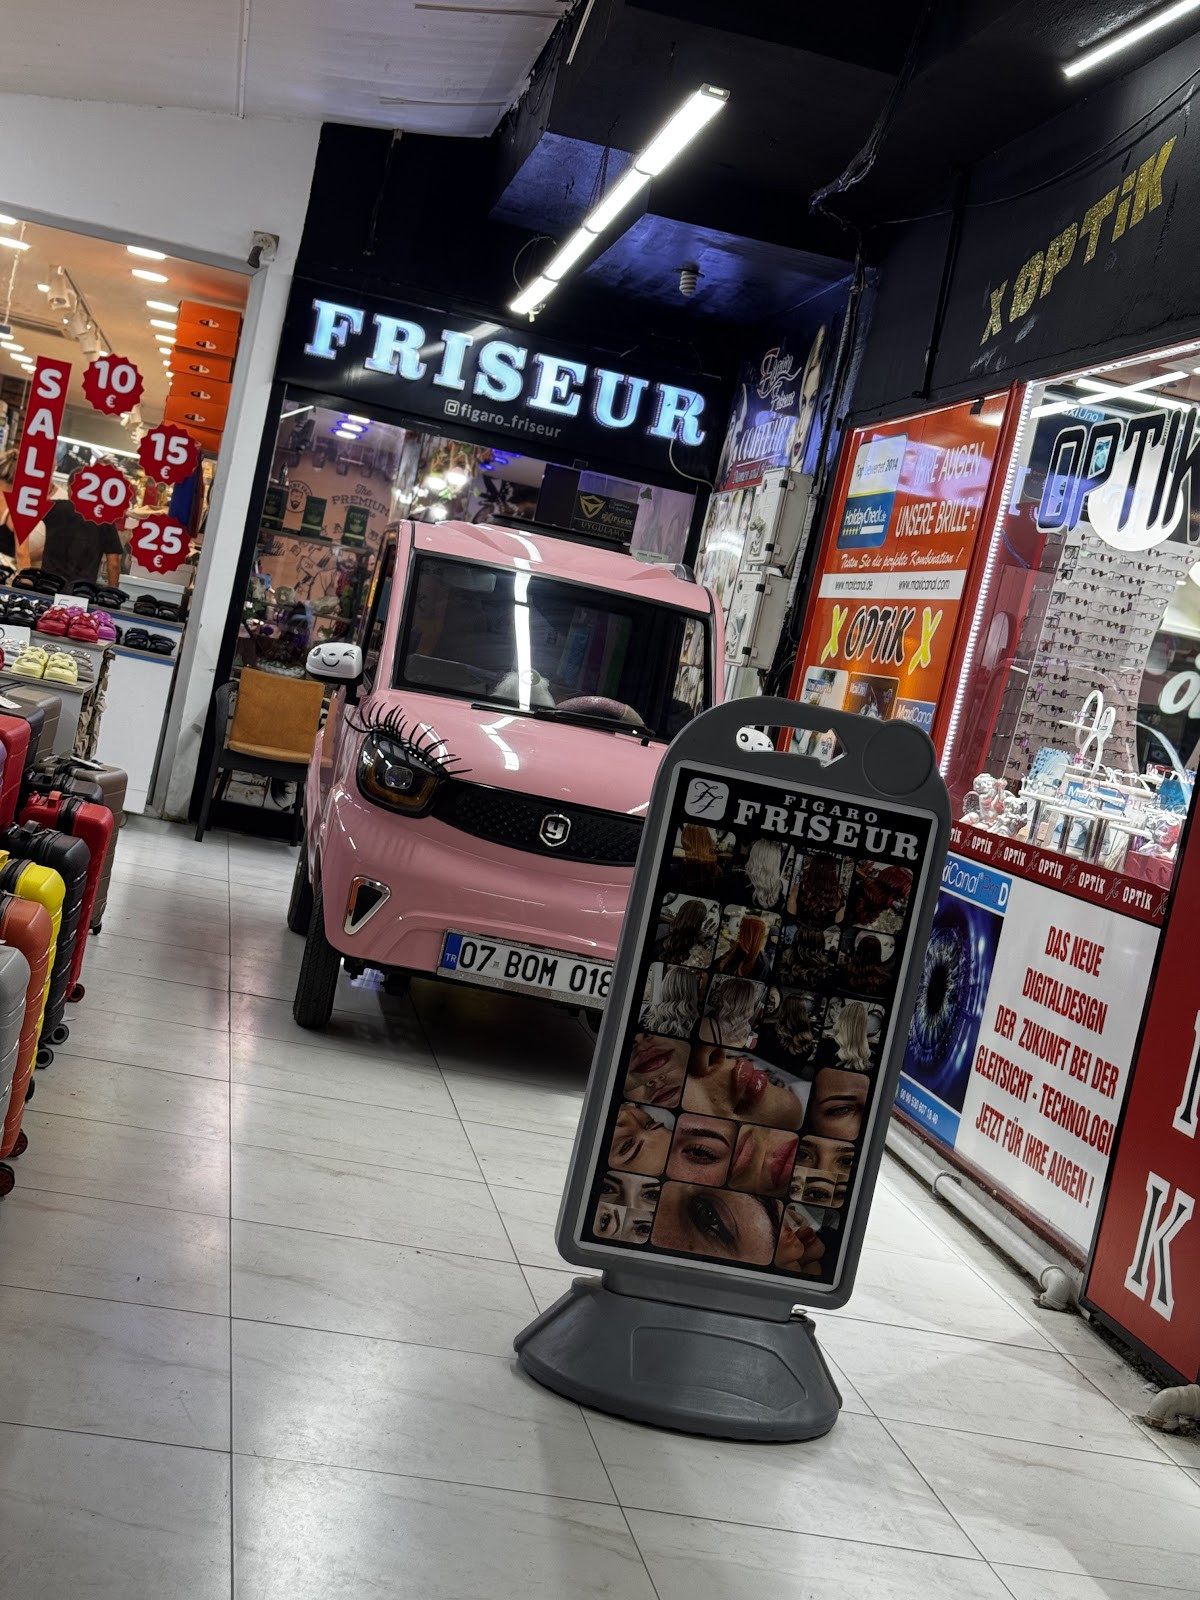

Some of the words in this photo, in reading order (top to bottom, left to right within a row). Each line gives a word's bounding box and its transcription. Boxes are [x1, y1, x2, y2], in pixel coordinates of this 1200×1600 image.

[979, 279, 1008, 347] X
[94, 360, 137, 394] 10
[304, 298, 706, 447] FRISEUR
[105, 394, 117, 408] €
[460, 402, 562, 439] figaro_friseur
[17, 368, 62, 518] SALE
[150, 433, 189, 465] 15
[160, 466, 171, 479] €
[914, 451, 940, 484] IHRE
[937, 441, 985, 483] AUGEN
[77, 472, 127, 507] 20
[331, 494, 390, 517] PREMIUM
[93, 504, 104, 518] €
[895, 501, 938, 538] UNSERE
[934, 496, 973, 535] BRILLE
[137, 522, 183, 555] 25
[153, 554, 163, 568] €
[908, 548, 955, 567] Kombination
[783, 794, 879, 824] FIGARO
[733, 799, 919, 861] FRISEUR
[445, 953, 457, 963] TR
[459, 941, 497, 972] 07
[503, 950, 559, 987] BOM
[569, 964, 613, 998] 018
[1044, 925, 1071, 963] DAS
[1069, 935, 1105, 978] NEUE
[1022, 967, 1109, 1036] DIGITALDESIGN
[994, 1004, 1018, 1042] DER
[1018, 1017, 1072, 1071] ZUKUNFT
[1068, 1044, 1093, 1085] BEI
[1090, 1056, 1120, 1100] DER
[975, 1044, 1034, 1104] GLEITSICHT
[975, 1101, 1006, 1144] JETZT
[1002, 1116, 1025, 1159] FÜR
[1022, 1132, 1050, 1177] IHRE
[1046, 1150, 1089, 1204] AUGEN
[1085, 1175, 1095, 1209] !
